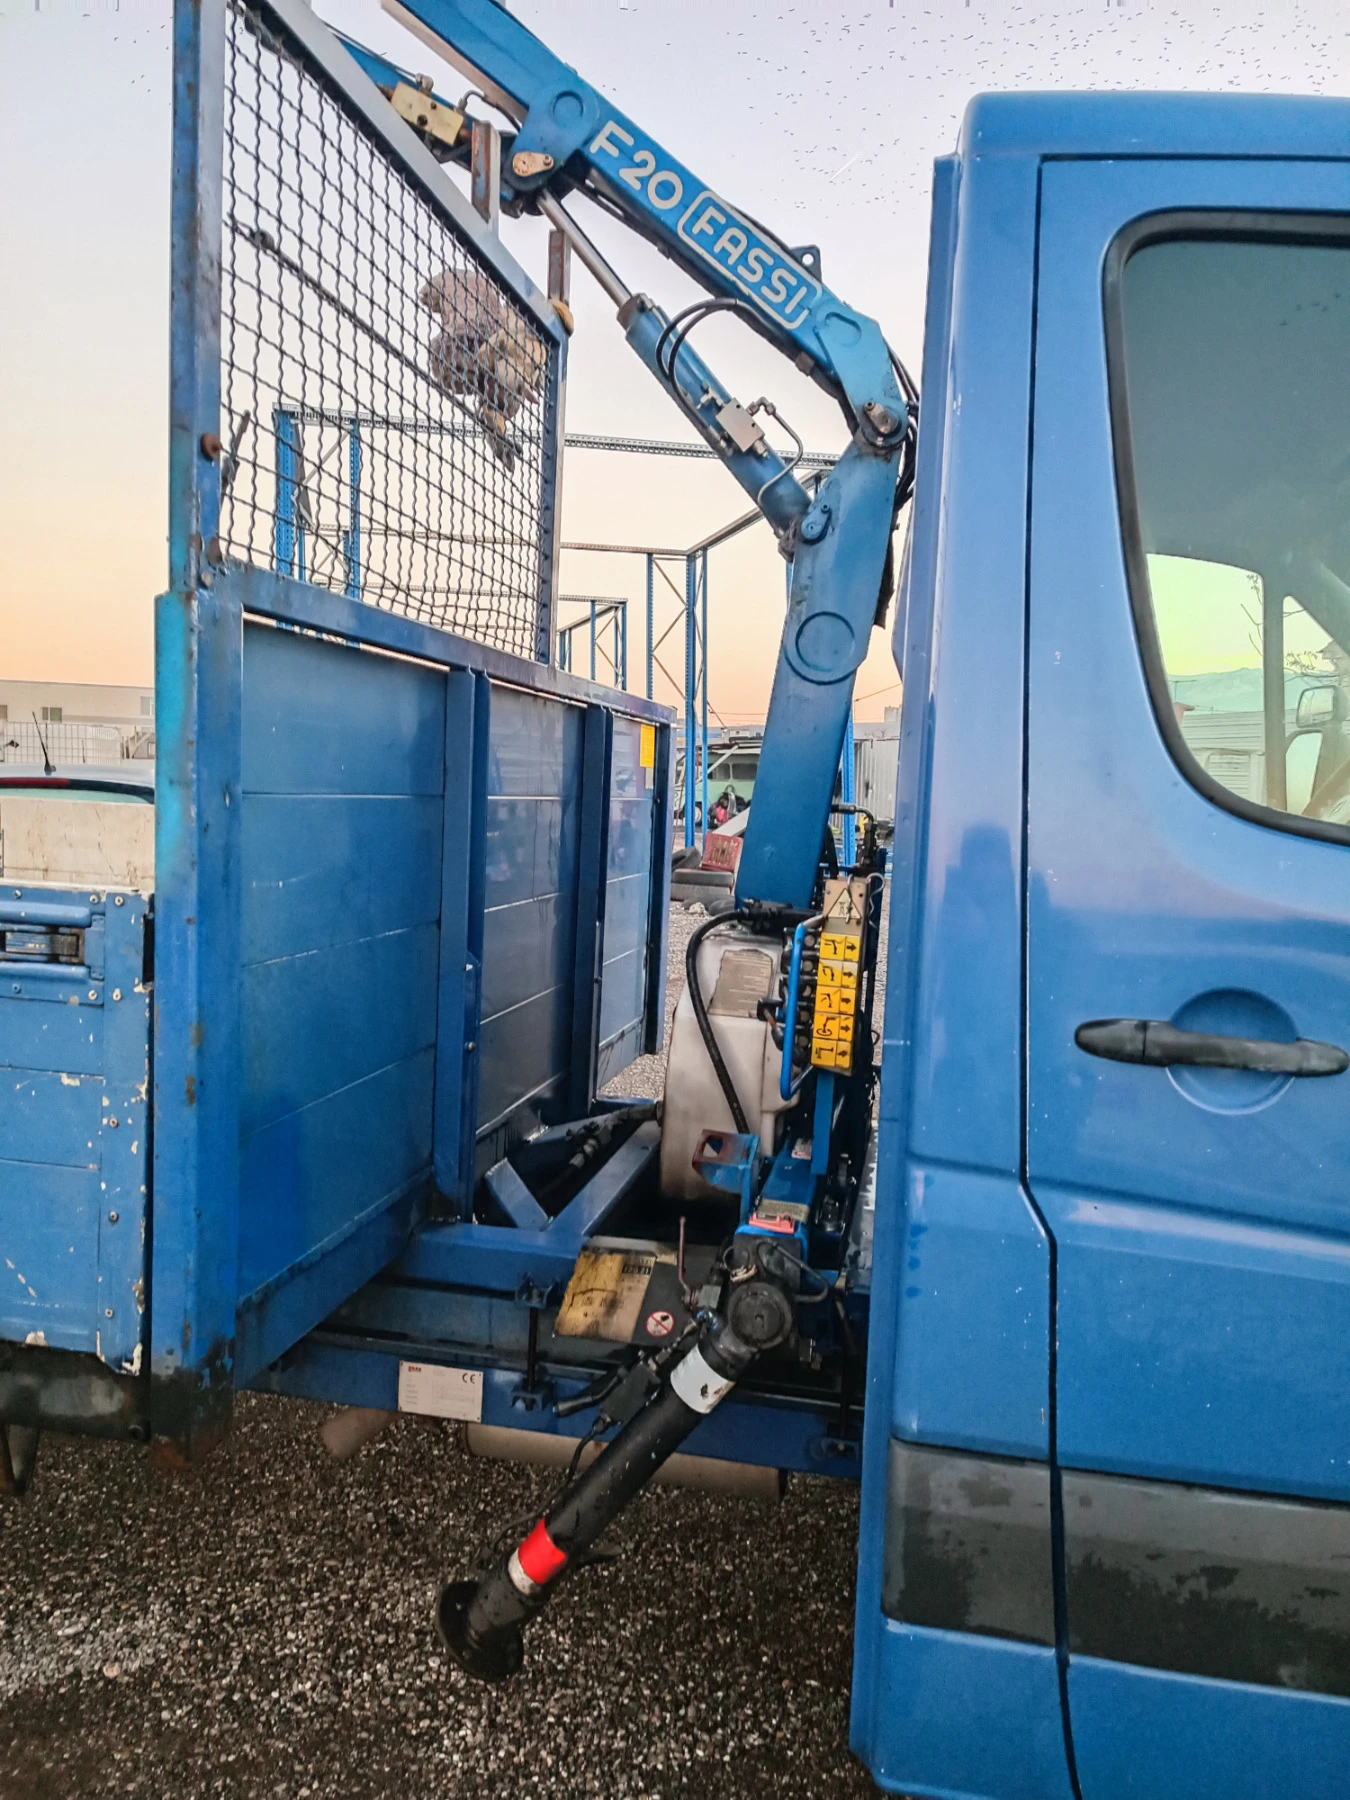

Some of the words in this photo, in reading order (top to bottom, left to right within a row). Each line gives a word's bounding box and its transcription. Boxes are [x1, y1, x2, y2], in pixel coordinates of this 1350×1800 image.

[589, 120, 683, 210] F20
[691, 206, 808, 314] FASSI
[462, 1373, 476, 1384] CE
